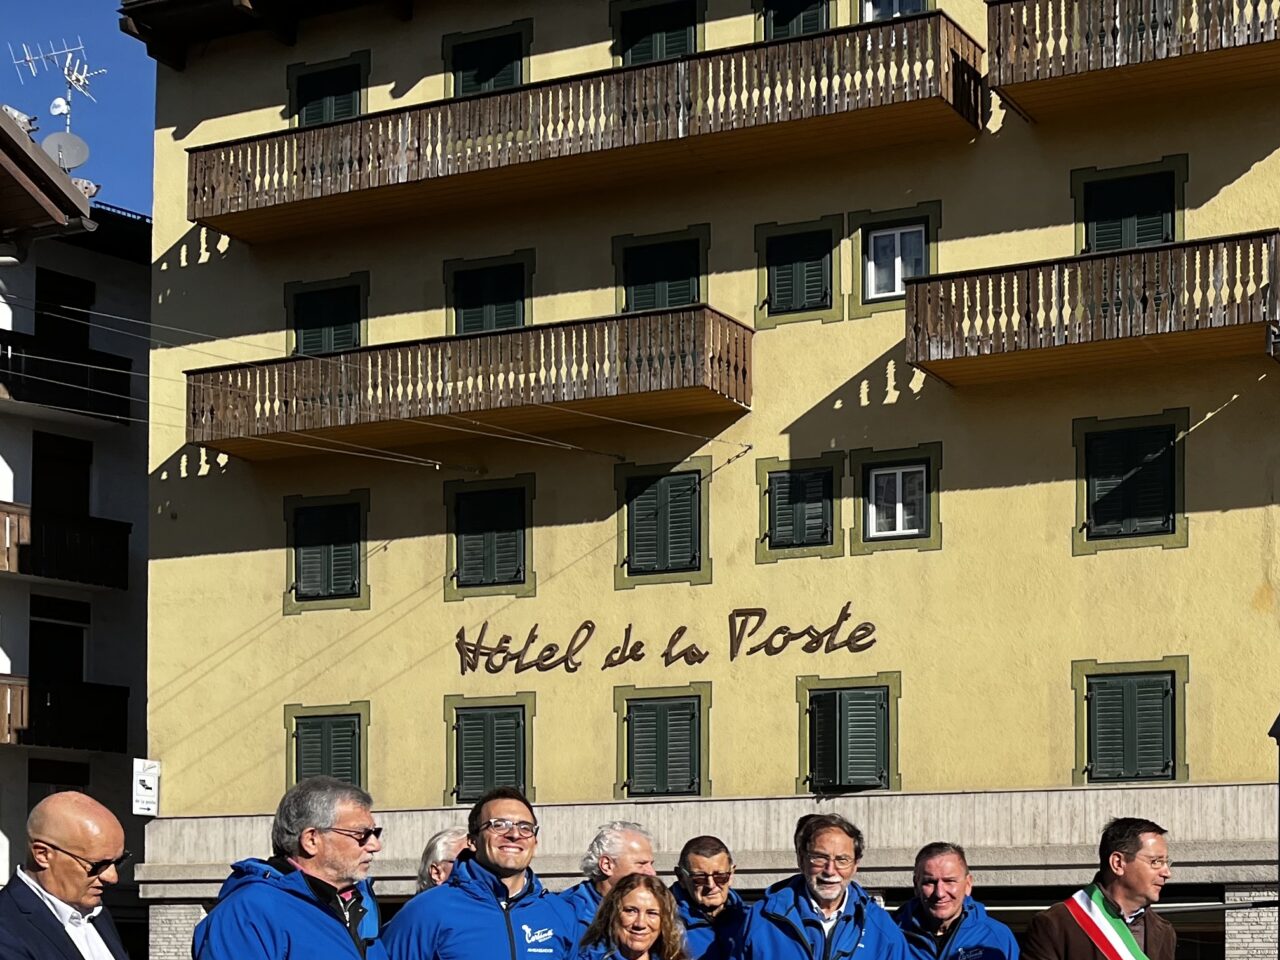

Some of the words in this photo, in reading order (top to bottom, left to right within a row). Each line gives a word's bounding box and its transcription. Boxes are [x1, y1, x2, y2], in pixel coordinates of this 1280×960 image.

[601, 623, 645, 671] de
[661, 625, 710, 667] la
[728, 601, 877, 661] Poste
